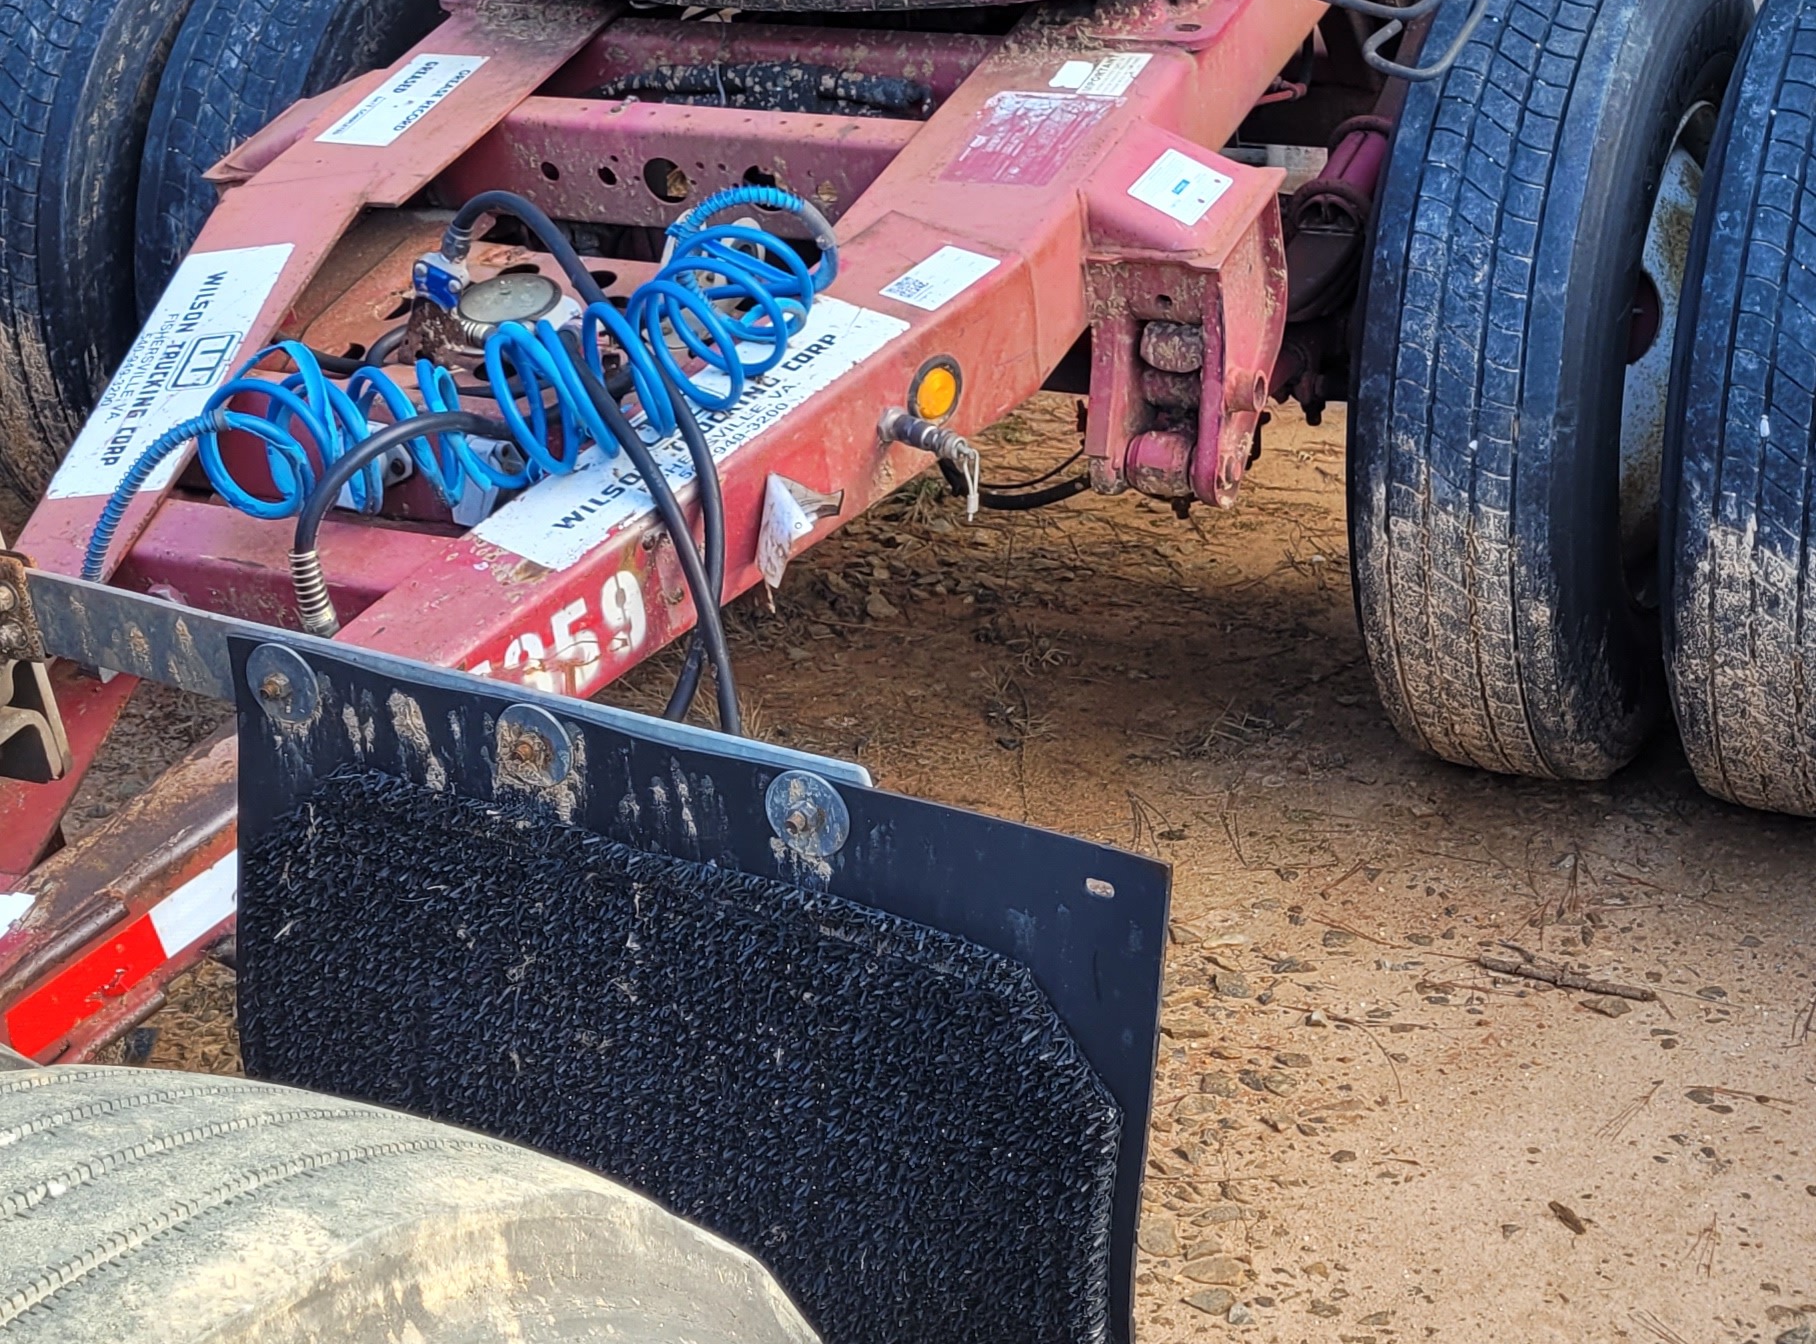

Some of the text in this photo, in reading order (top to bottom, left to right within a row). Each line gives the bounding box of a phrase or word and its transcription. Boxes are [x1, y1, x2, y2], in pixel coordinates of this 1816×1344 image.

[392, 60, 440, 94] GREASED
[393, 69, 472, 132] GREASE RECORD
[100, 270, 229, 466] WILSON TRUCKING CORP
[552, 463, 662, 530] WILSO
[780, 333, 837, 371] CORP
